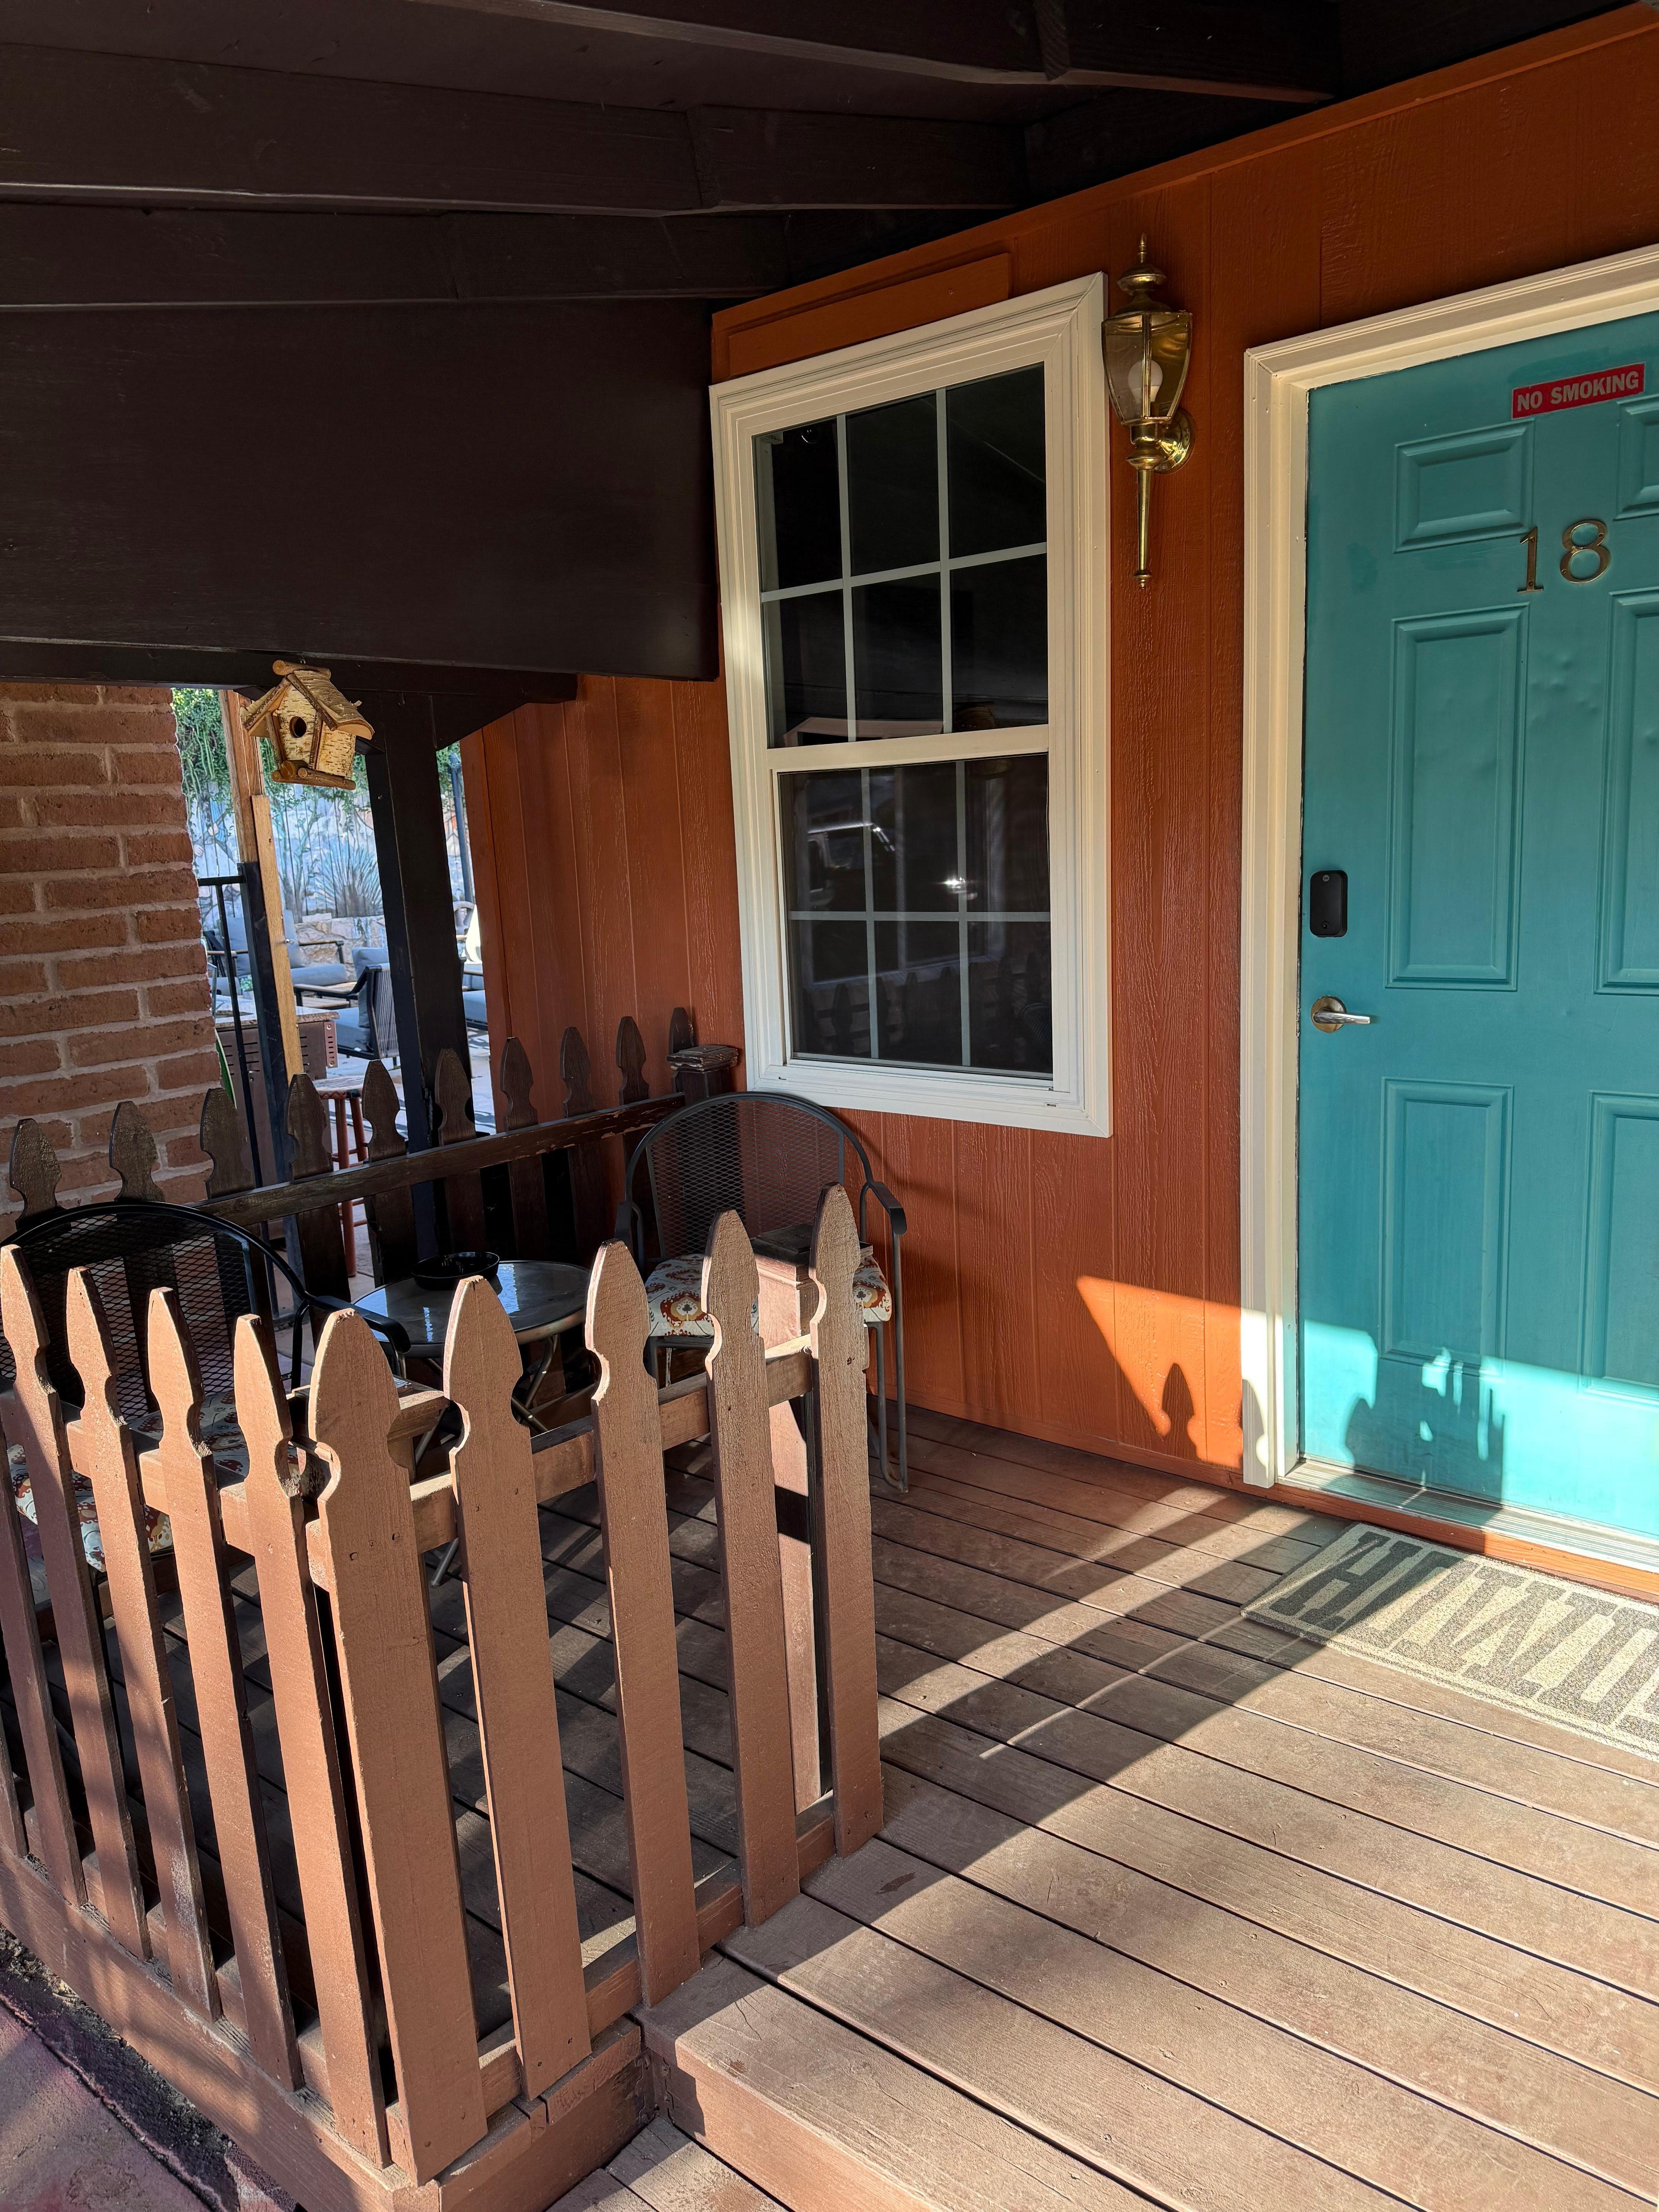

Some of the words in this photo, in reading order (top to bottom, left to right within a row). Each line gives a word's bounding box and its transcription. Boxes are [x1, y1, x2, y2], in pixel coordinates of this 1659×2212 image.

[1517, 391, 1542, 411] NO
[1551, 371, 1639, 404] SMOKING
[1517, 520, 1611, 593] 18
[1269, 1531, 1659, 1743] HOWD
